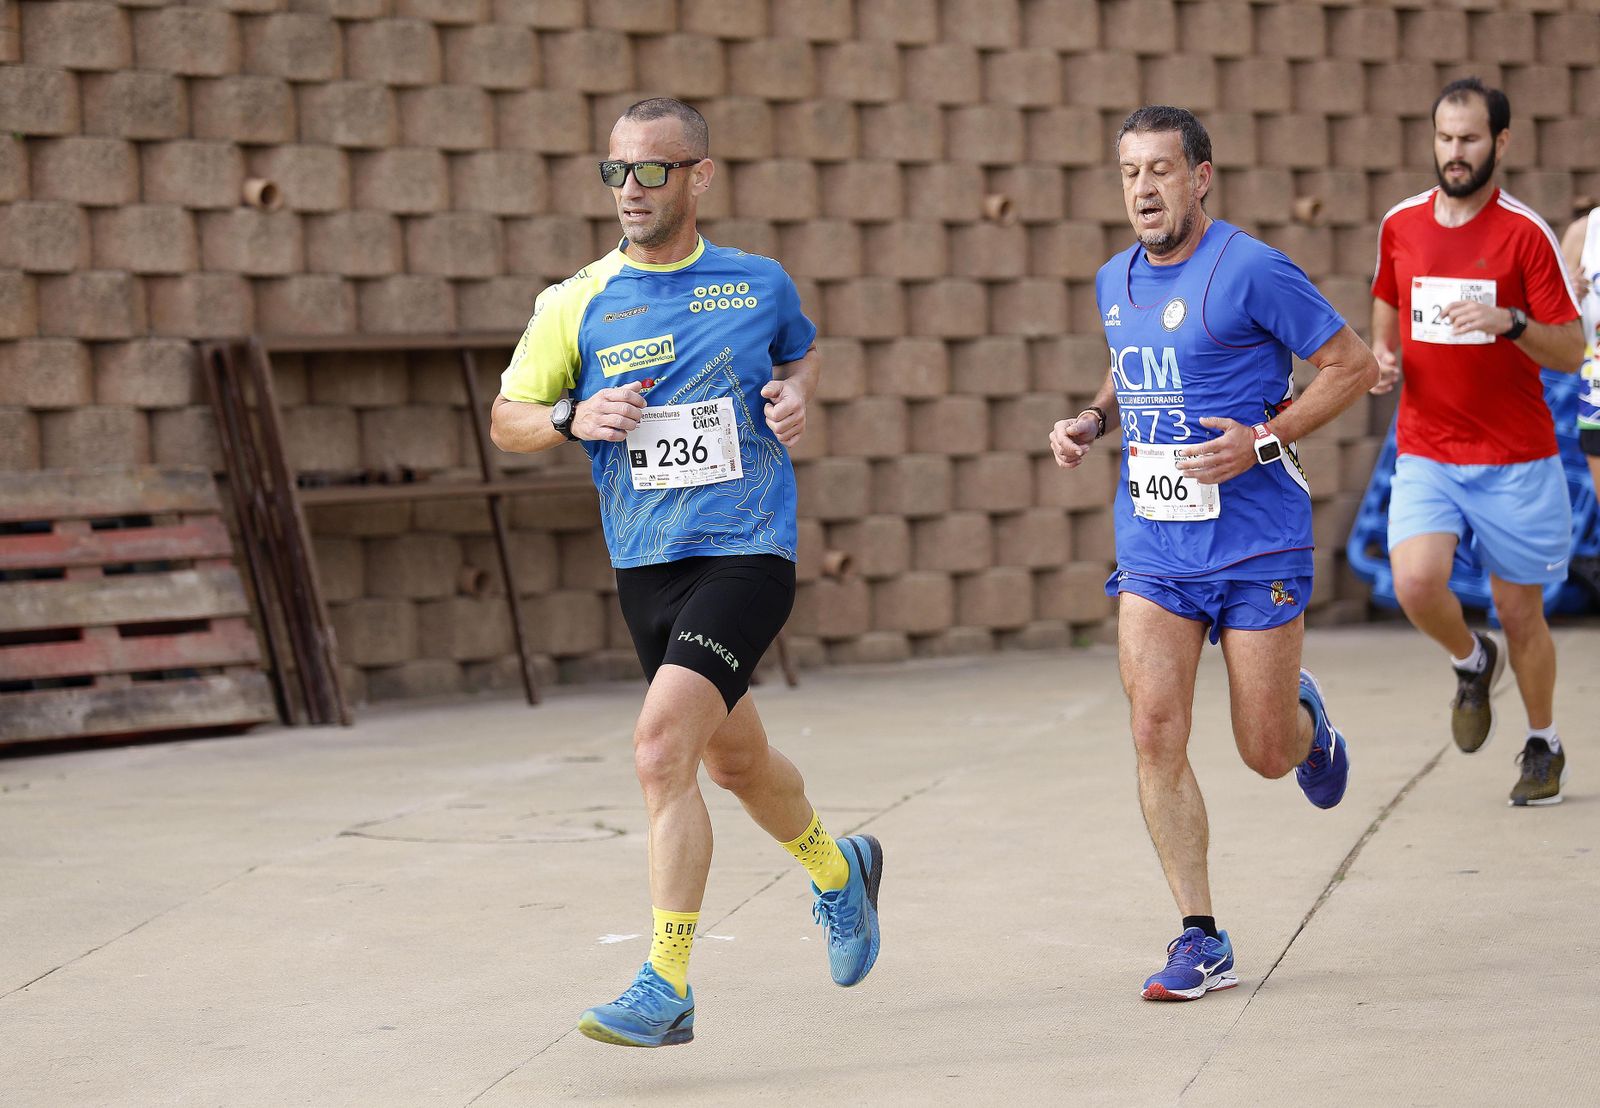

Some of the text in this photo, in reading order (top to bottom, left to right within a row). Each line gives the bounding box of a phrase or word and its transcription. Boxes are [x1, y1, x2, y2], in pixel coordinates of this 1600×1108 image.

[691, 299, 755, 311] NEGRO
[600, 339, 672, 369] naocon
[1110, 345, 1183, 391] RCM
[691, 403, 718, 416] CORRE
[693, 416, 720, 430] CAUSA
[656, 435, 708, 467] 236
[1146, 475, 1188, 501] 406
[678, 631, 739, 672] HANKER
